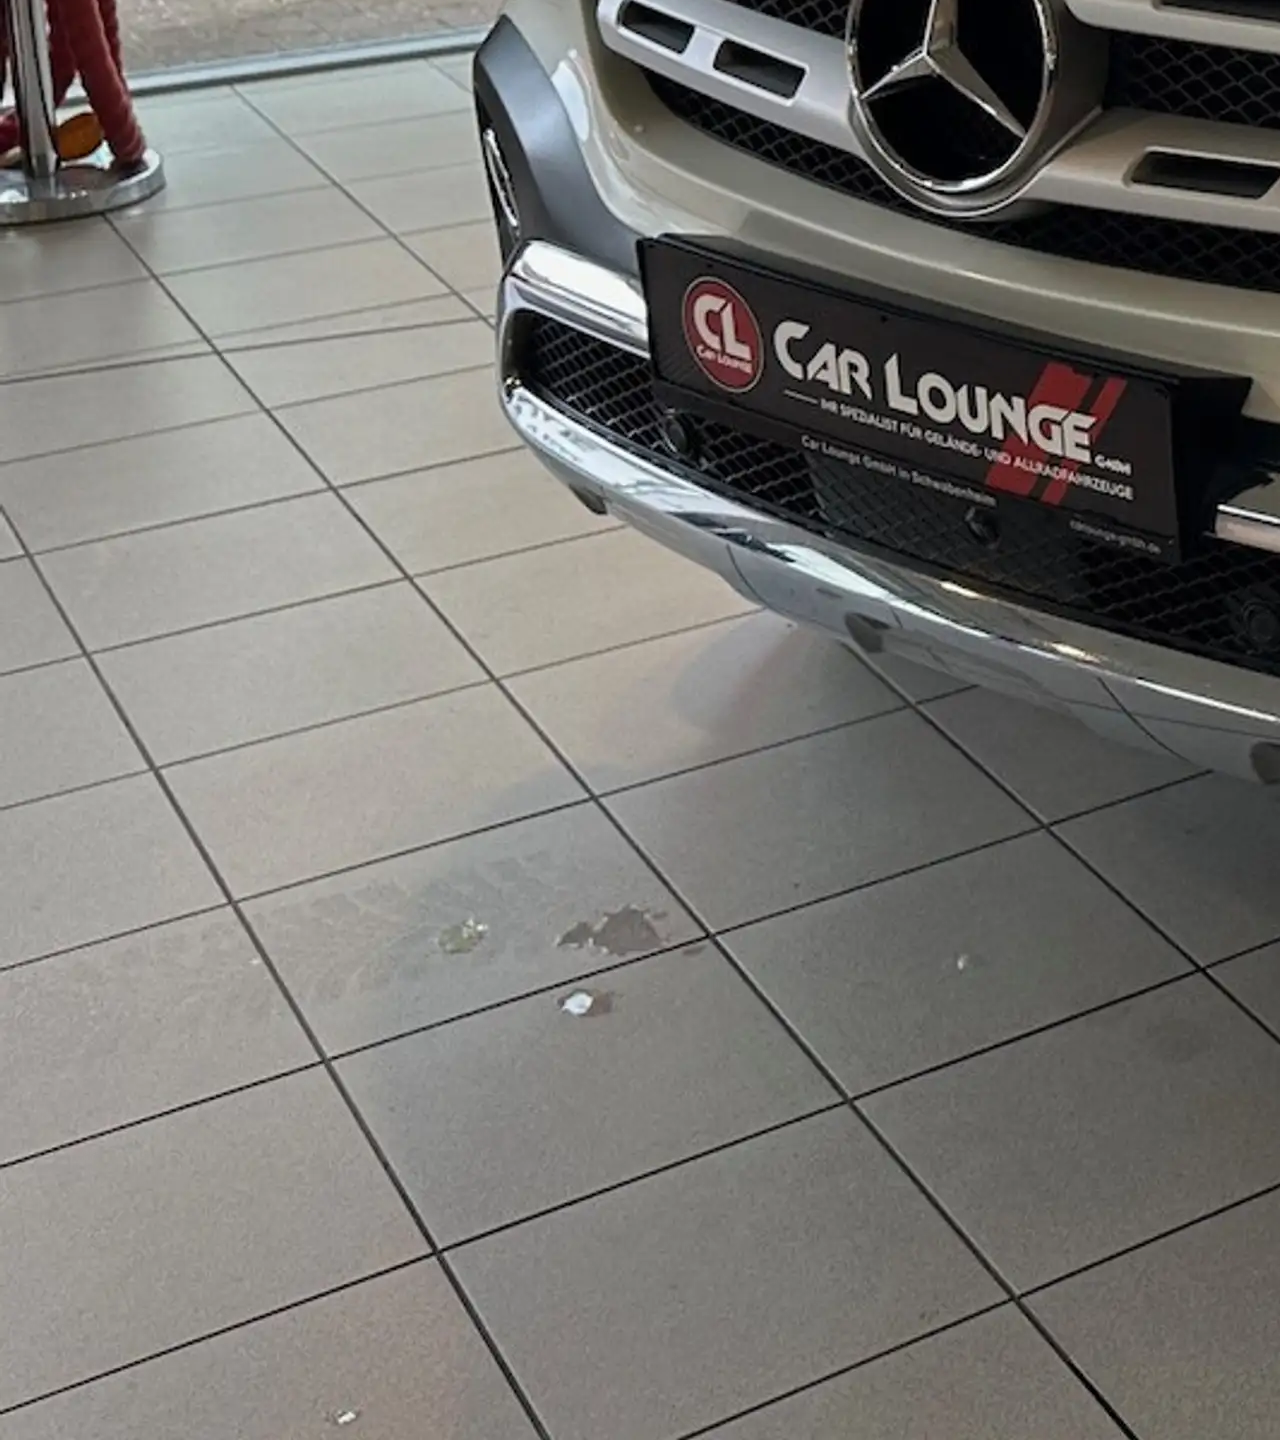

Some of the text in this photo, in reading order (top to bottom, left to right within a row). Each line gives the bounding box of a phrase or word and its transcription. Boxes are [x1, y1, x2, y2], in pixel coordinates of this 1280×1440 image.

[693, 293, 752, 361] CL
[773, 320, 873, 401] CAR
[884, 352, 1097, 465] LOUNGE
[839, 402, 898, 433] SPEZIALIST
[801, 434, 819, 452] Car
